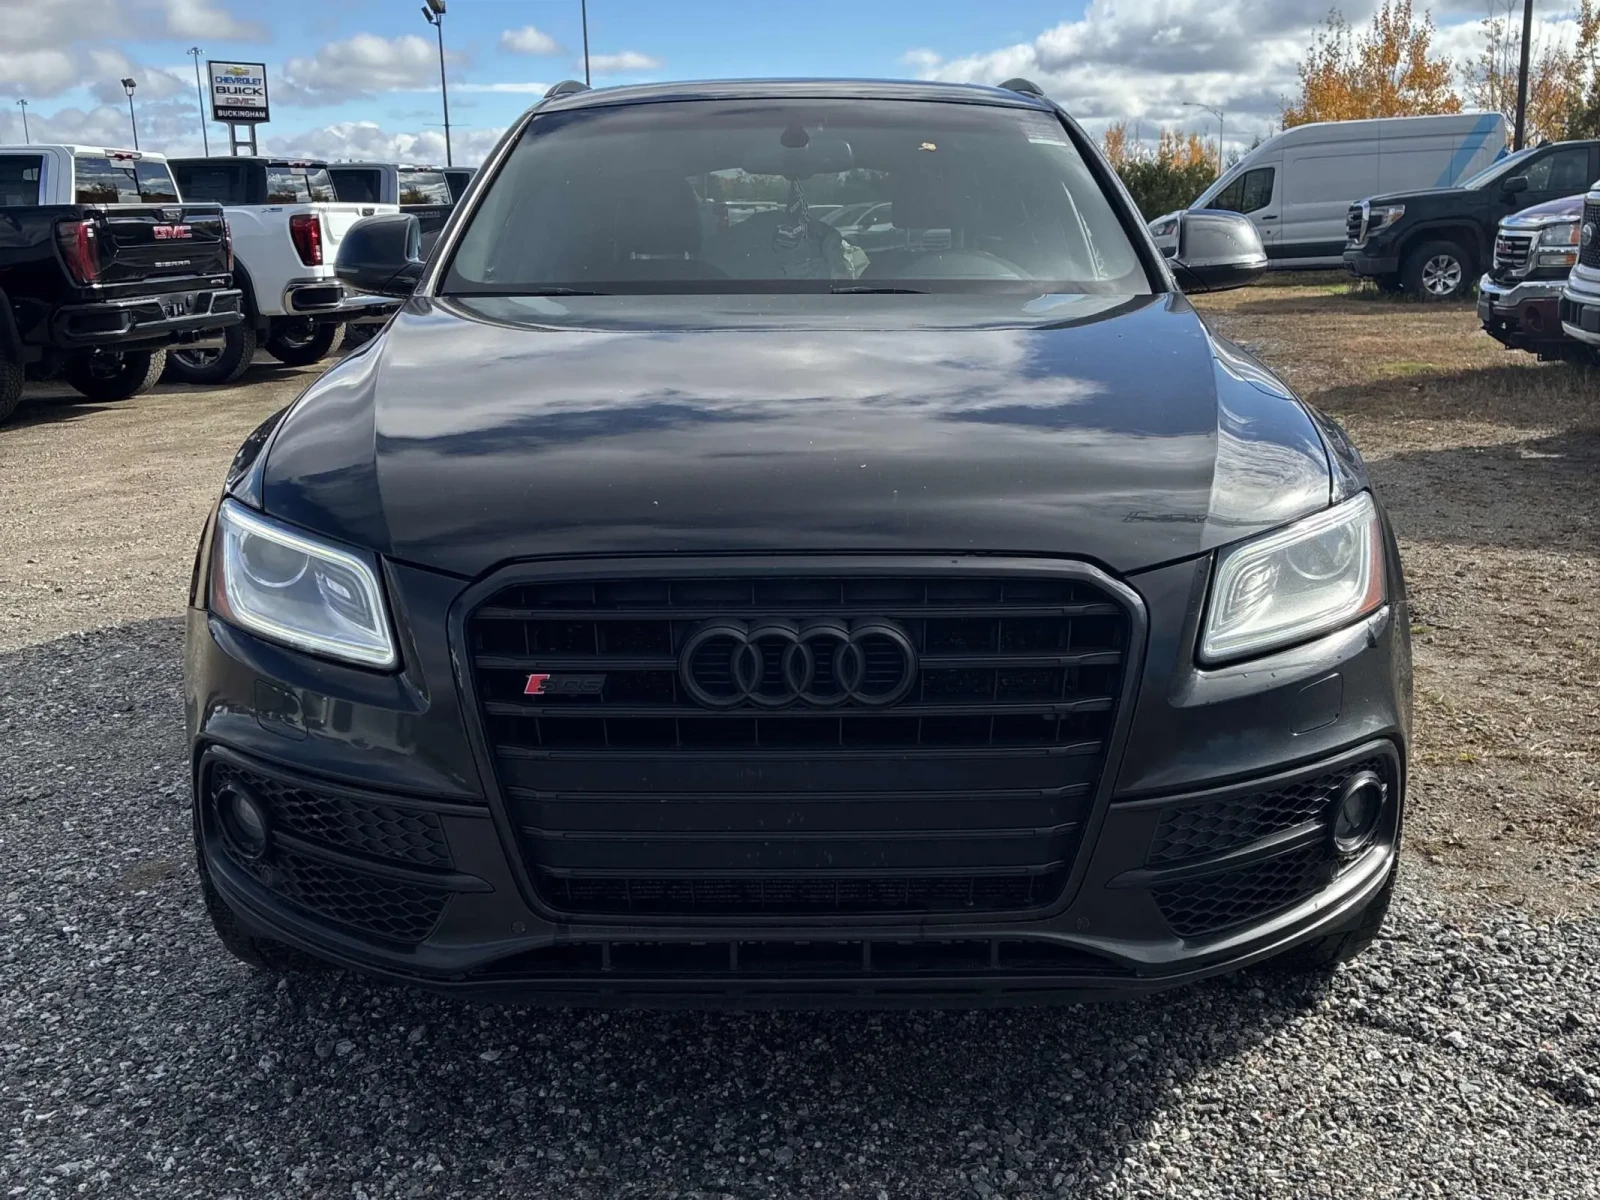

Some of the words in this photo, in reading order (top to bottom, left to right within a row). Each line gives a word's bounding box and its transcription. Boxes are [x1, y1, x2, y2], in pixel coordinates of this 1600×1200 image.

[215, 76, 262, 85] CHEVROLET
[215, 86, 263, 96] BUICK
[226, 97, 256, 106] GMC
[217, 109, 266, 118] BUCKINGHAM
[153, 225, 192, 239] GMC
[154, 259, 191, 268] SIERRA
